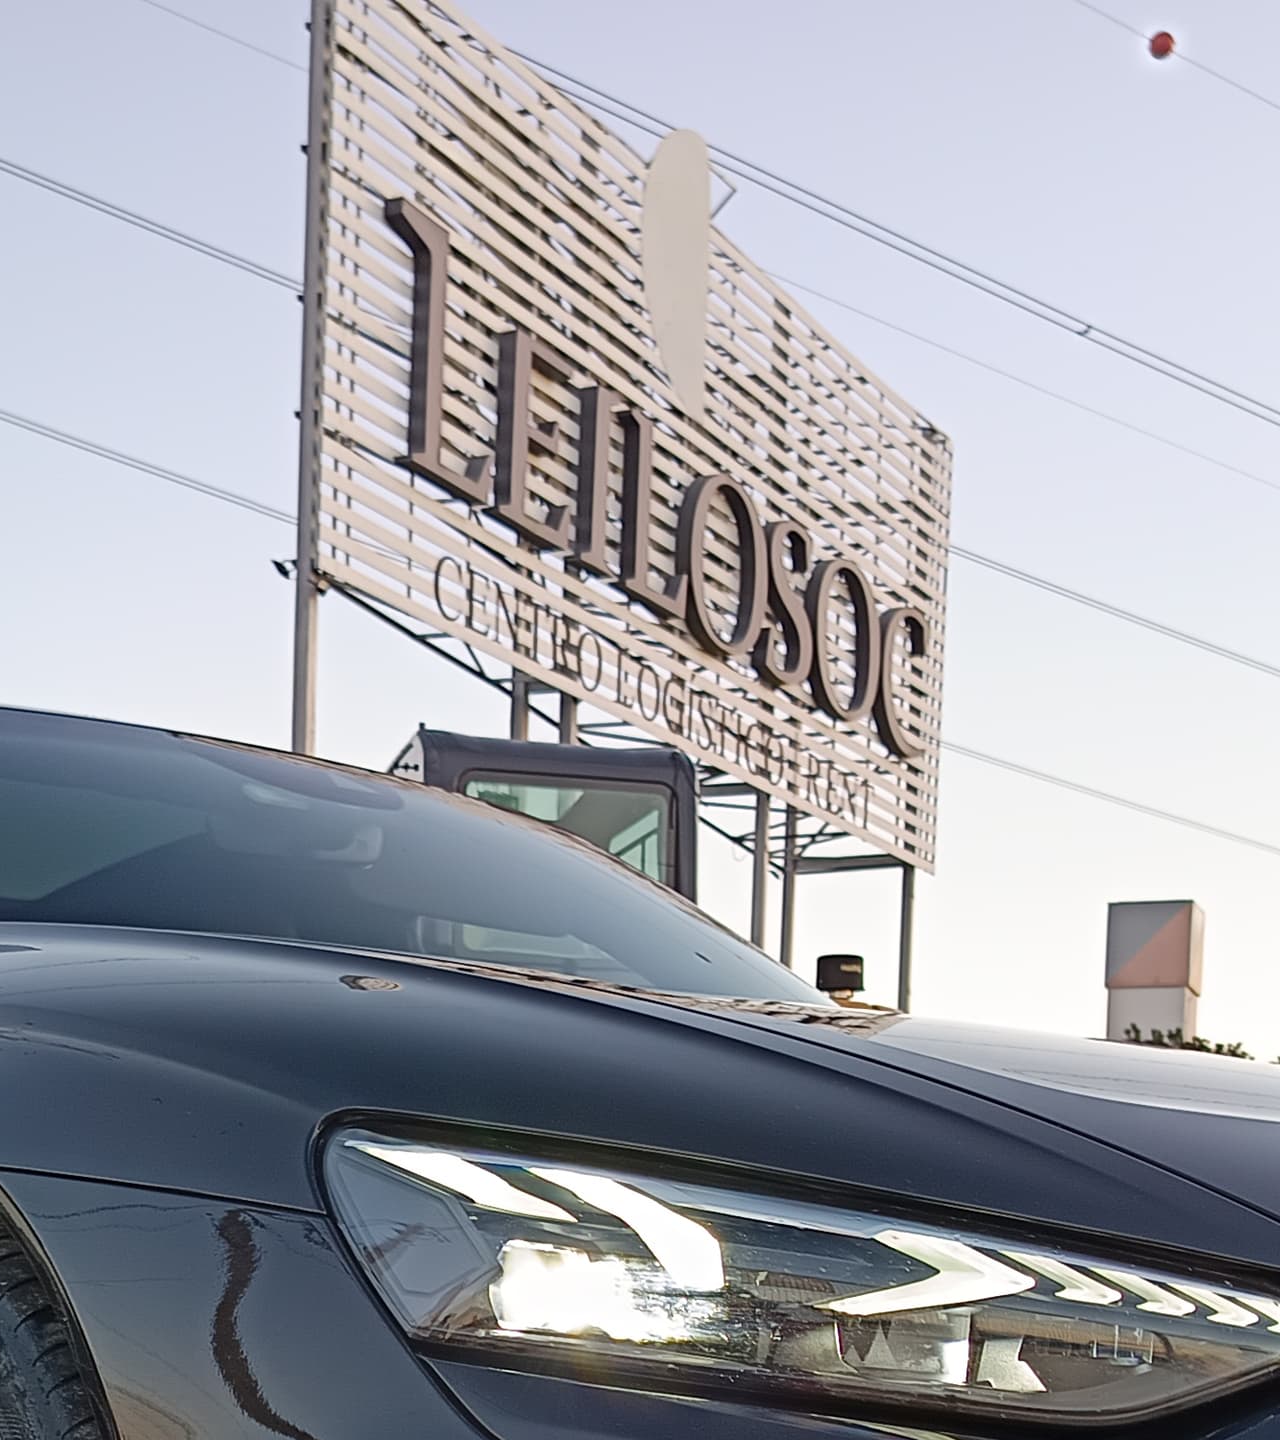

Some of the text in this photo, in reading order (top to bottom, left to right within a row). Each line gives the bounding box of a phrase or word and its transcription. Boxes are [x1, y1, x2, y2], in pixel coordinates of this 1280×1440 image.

[384, 196, 928, 760] LEILOSOC
[433, 555, 603, 692] CENTRO
[806, 754, 875, 830] RENT
